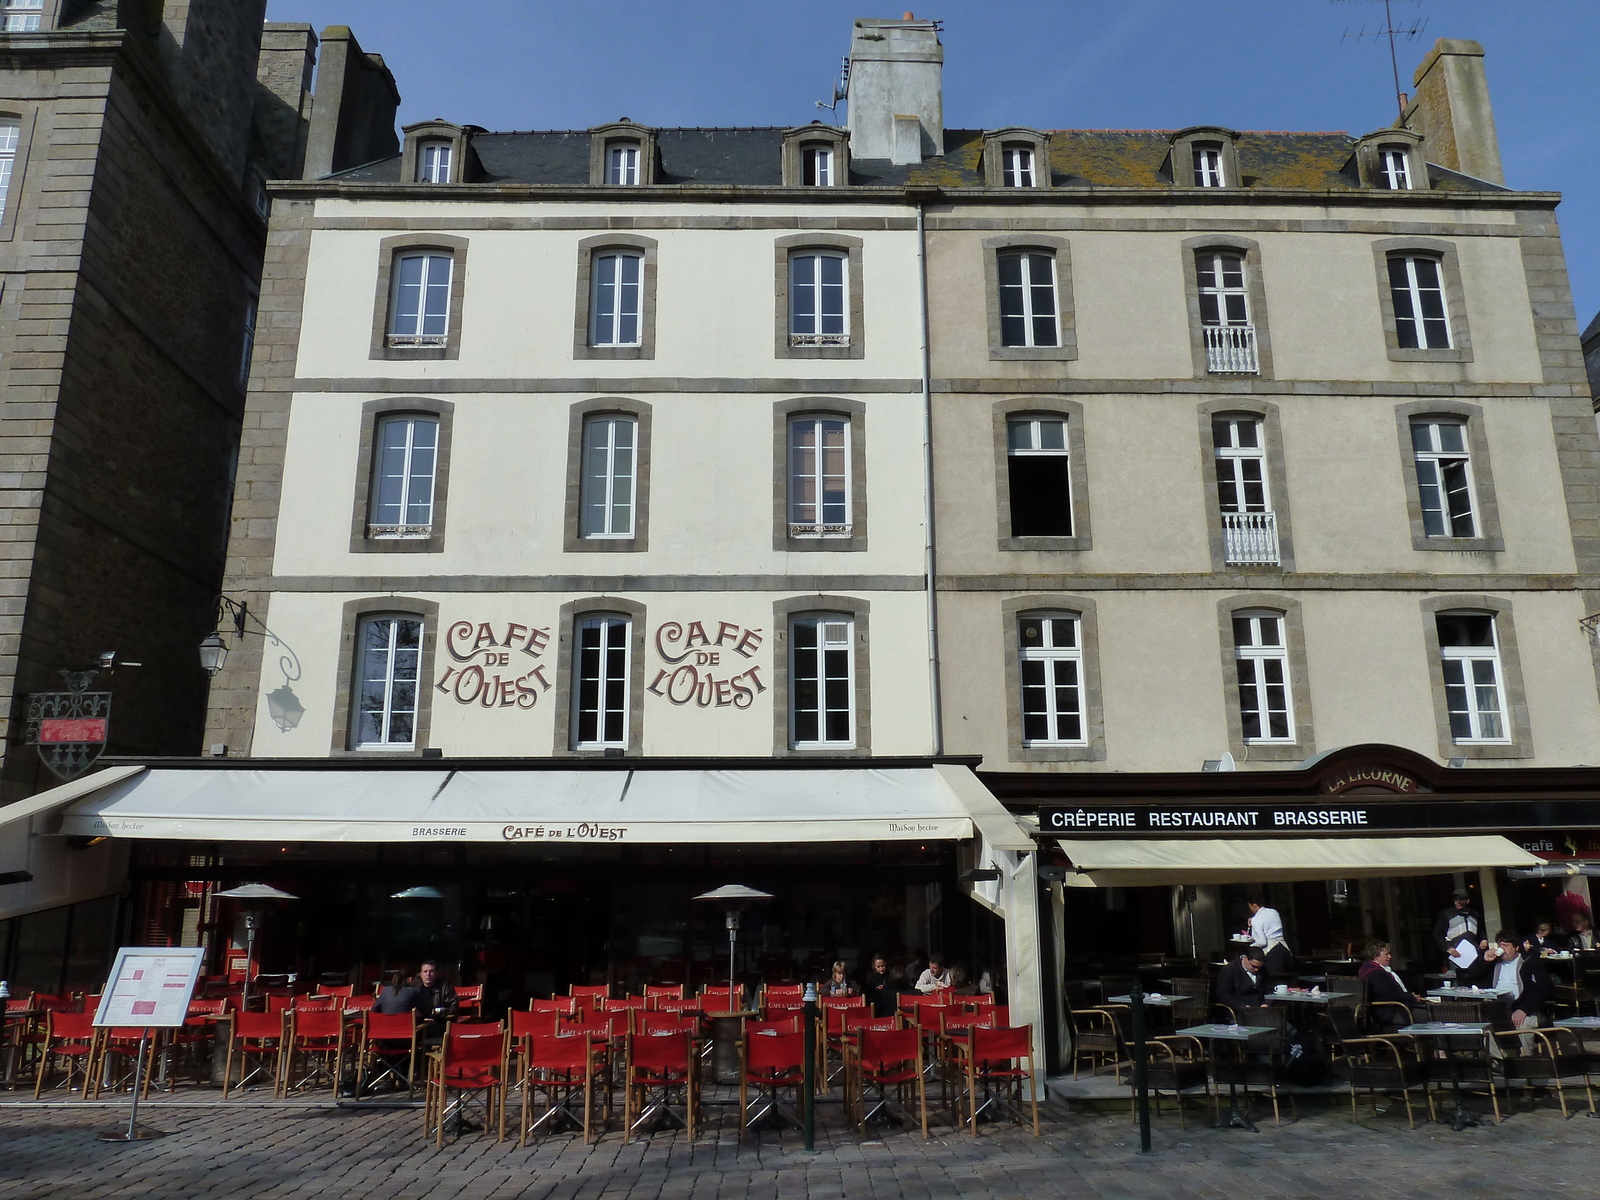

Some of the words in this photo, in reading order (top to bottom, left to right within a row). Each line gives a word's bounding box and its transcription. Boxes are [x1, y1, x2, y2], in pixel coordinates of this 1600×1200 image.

[446, 620, 551, 663] CAFÉ
[655, 620, 764, 664] CAFÉ
[484, 651, 510, 667] DE
[695, 651, 720, 667] DE
[434, 664, 552, 710] L'OUEST
[646, 664, 767, 710] L'OUEST
[1326, 775, 1346, 793] LA
[1348, 767, 1413, 792] LICORNE
[1051, 809, 1136, 827] CRÊPERIE
[1149, 811, 1259, 827] RESTAURANT
[1273, 810, 1368, 826] BRASSERIE
[412, 827, 467, 837] BRASSERIE
[502, 825, 545, 840] CAFÉ
[548, 829, 562, 837] DE
[566, 823, 628, 840] L'OUEST
[1523, 840, 1553, 851] café
